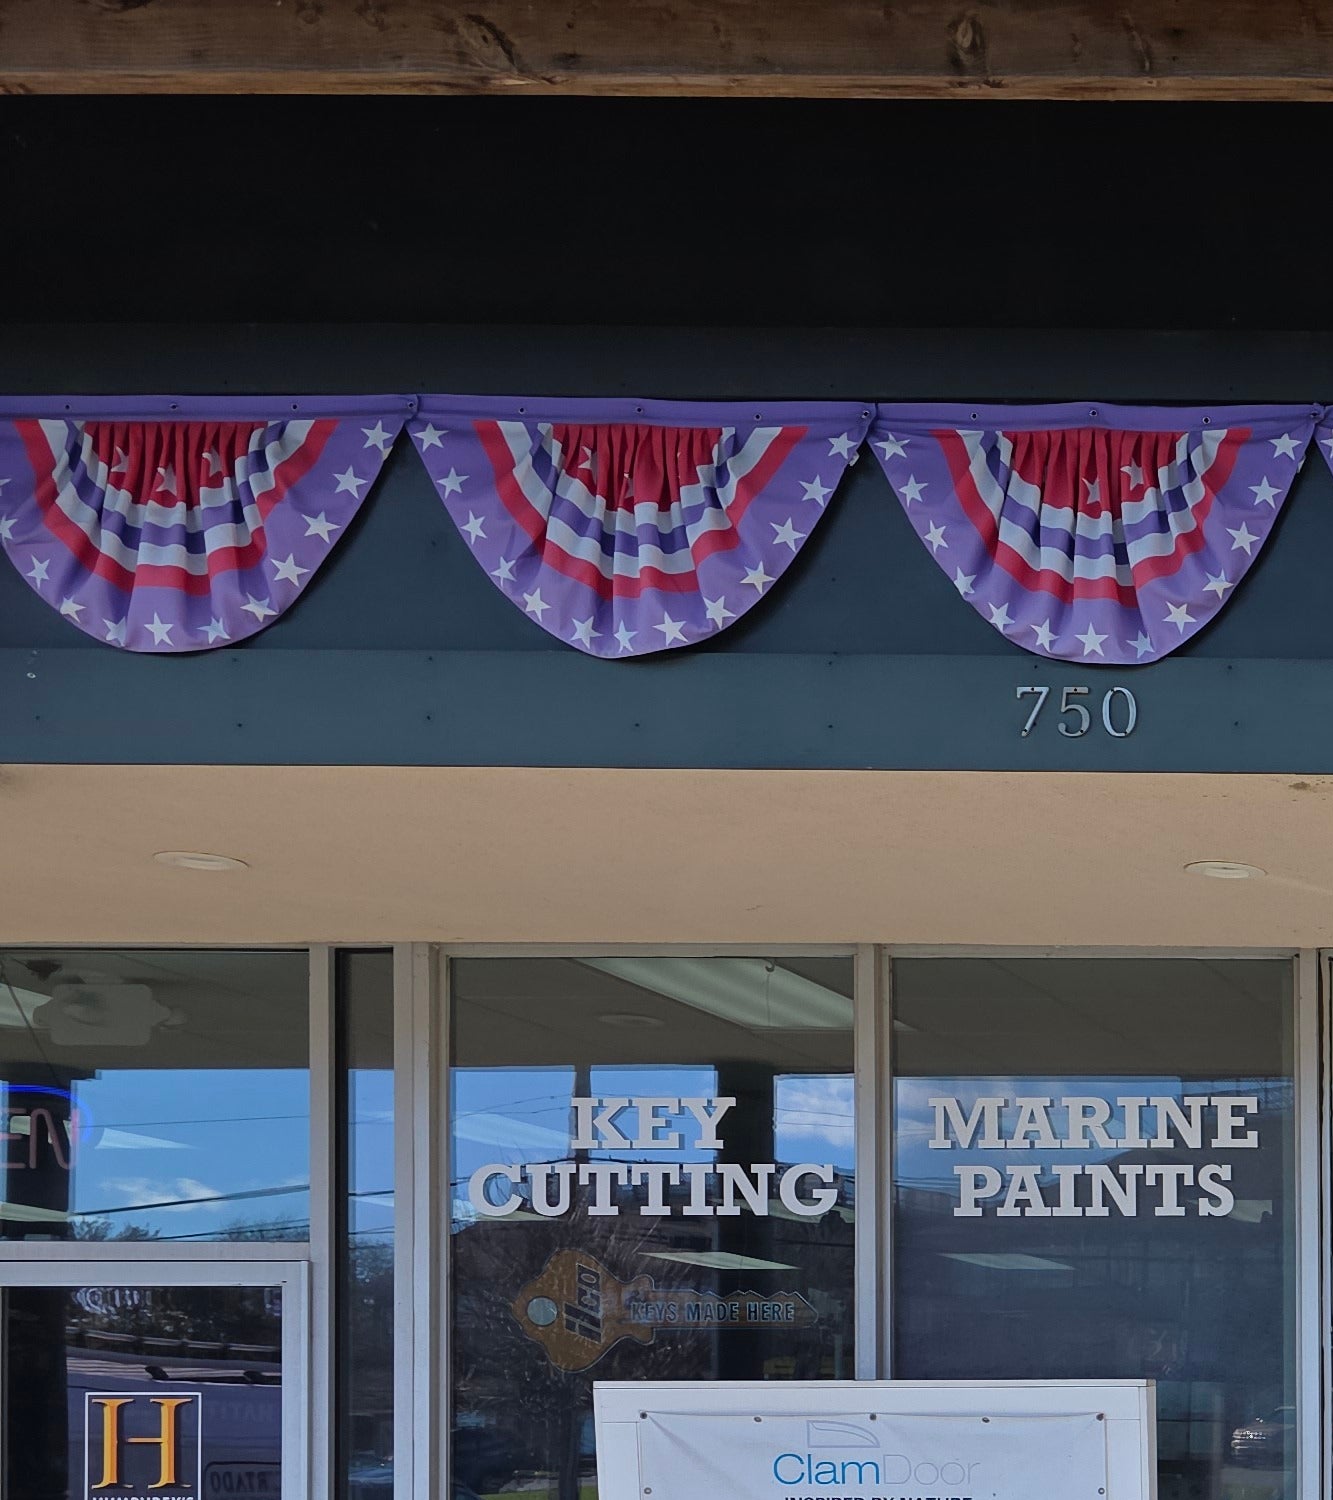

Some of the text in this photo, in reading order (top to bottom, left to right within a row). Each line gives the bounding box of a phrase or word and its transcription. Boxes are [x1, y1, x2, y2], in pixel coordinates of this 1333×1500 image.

[1016, 686, 1138, 738] 750
[569, 1096, 737, 1149] KEY
[928, 1096, 1260, 1149] MARINE
[468, 1163, 837, 1217] CUTTING
[953, 1164, 1235, 1217] PAINTS
[631, 1302, 795, 1322] KEYS MADE HERE
[91, 1398, 193, 1489] H
[773, 1453, 981, 1485] ClamDoor
